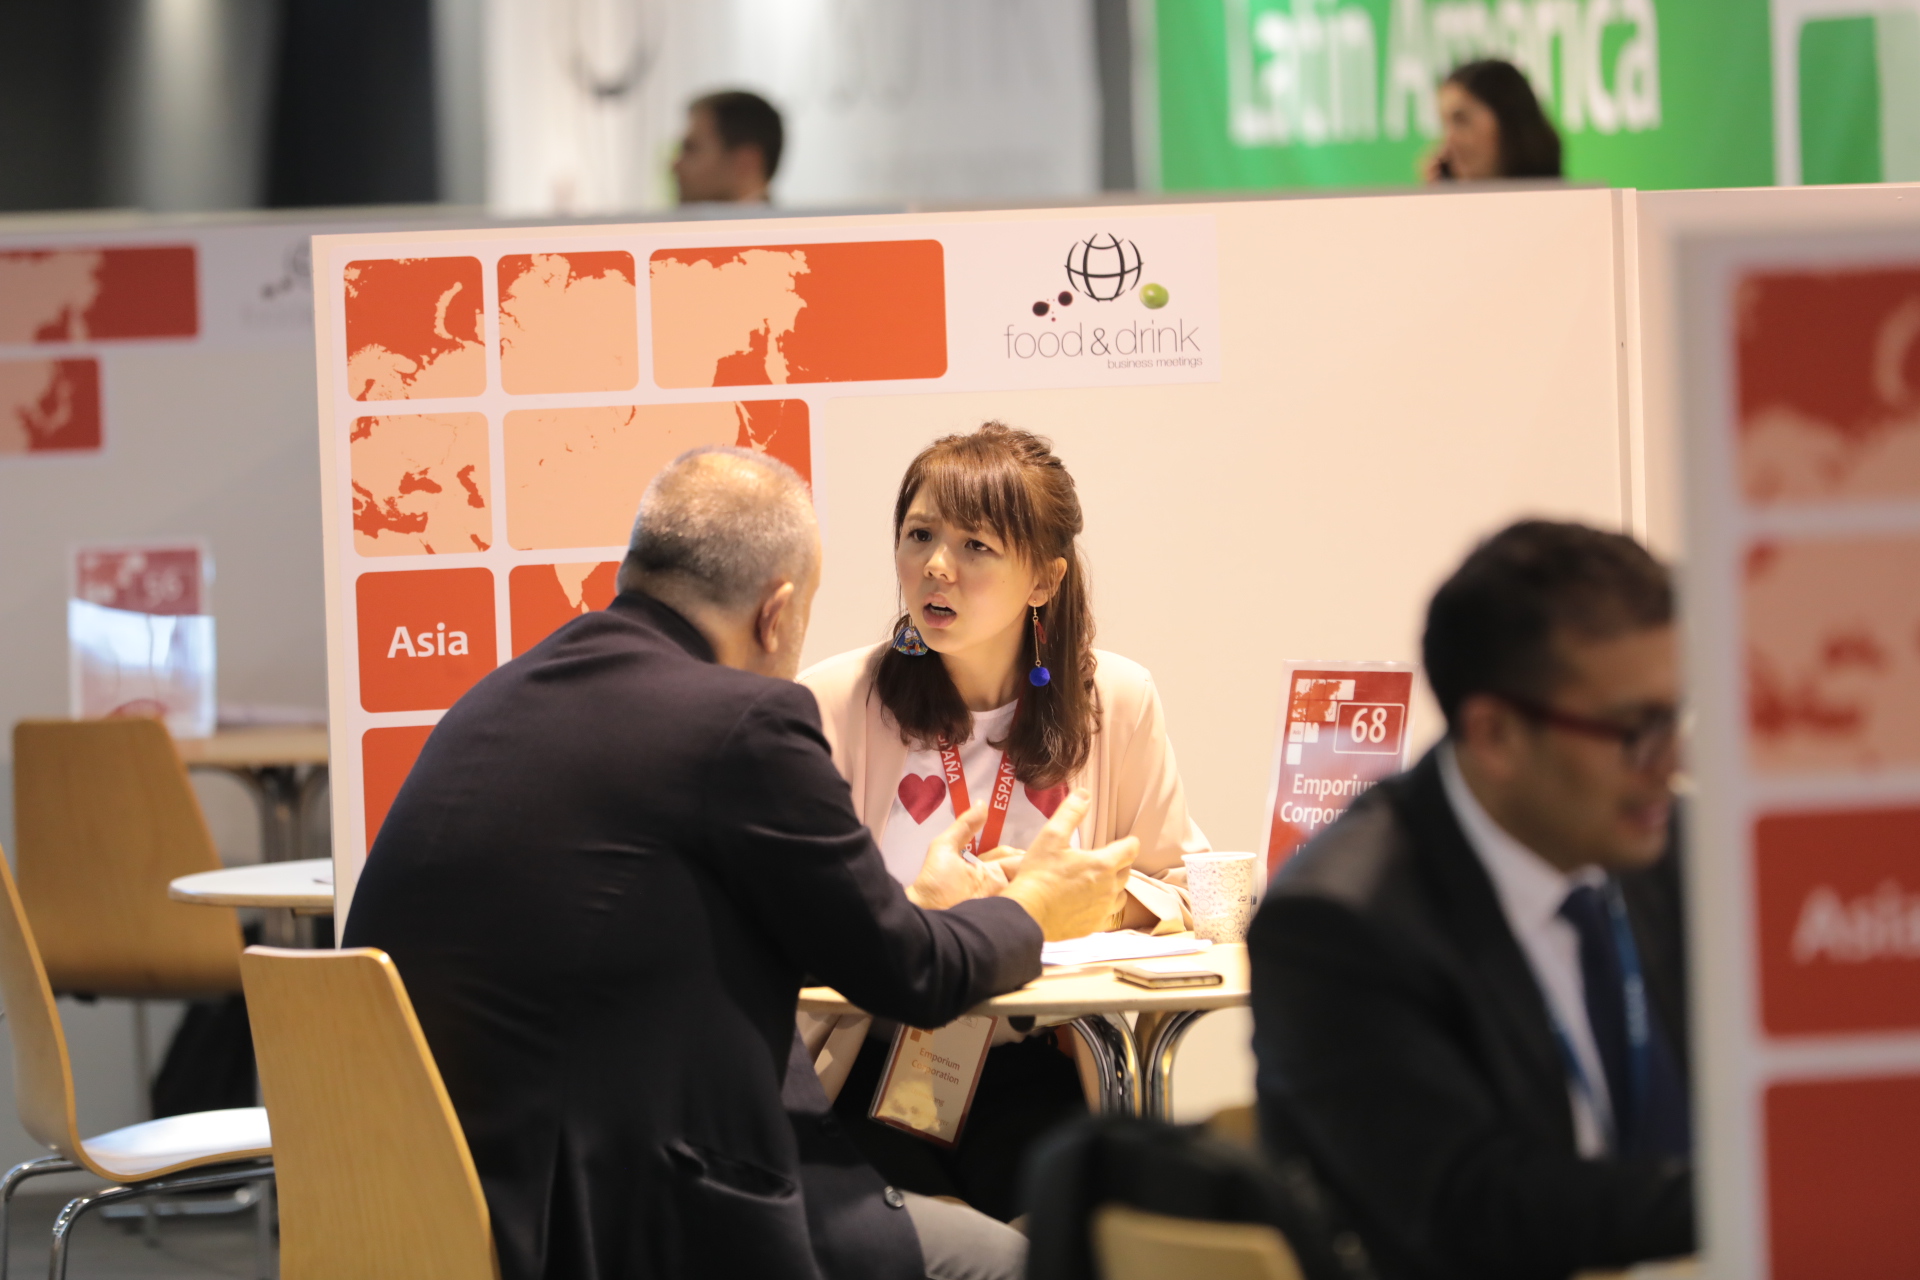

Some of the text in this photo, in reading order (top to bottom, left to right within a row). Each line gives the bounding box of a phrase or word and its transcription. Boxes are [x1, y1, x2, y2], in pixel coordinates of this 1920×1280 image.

[1003, 318, 1201, 359] food & drink
[1107, 356, 1203, 370] business meetings
[387, 622, 469, 658] Asia
[1351, 707, 1387, 743] 68
[1280, 802, 1349, 829] Corpor
[911, 1059, 960, 1085] Corporation
[919, 1047, 961, 1071] Emporium
